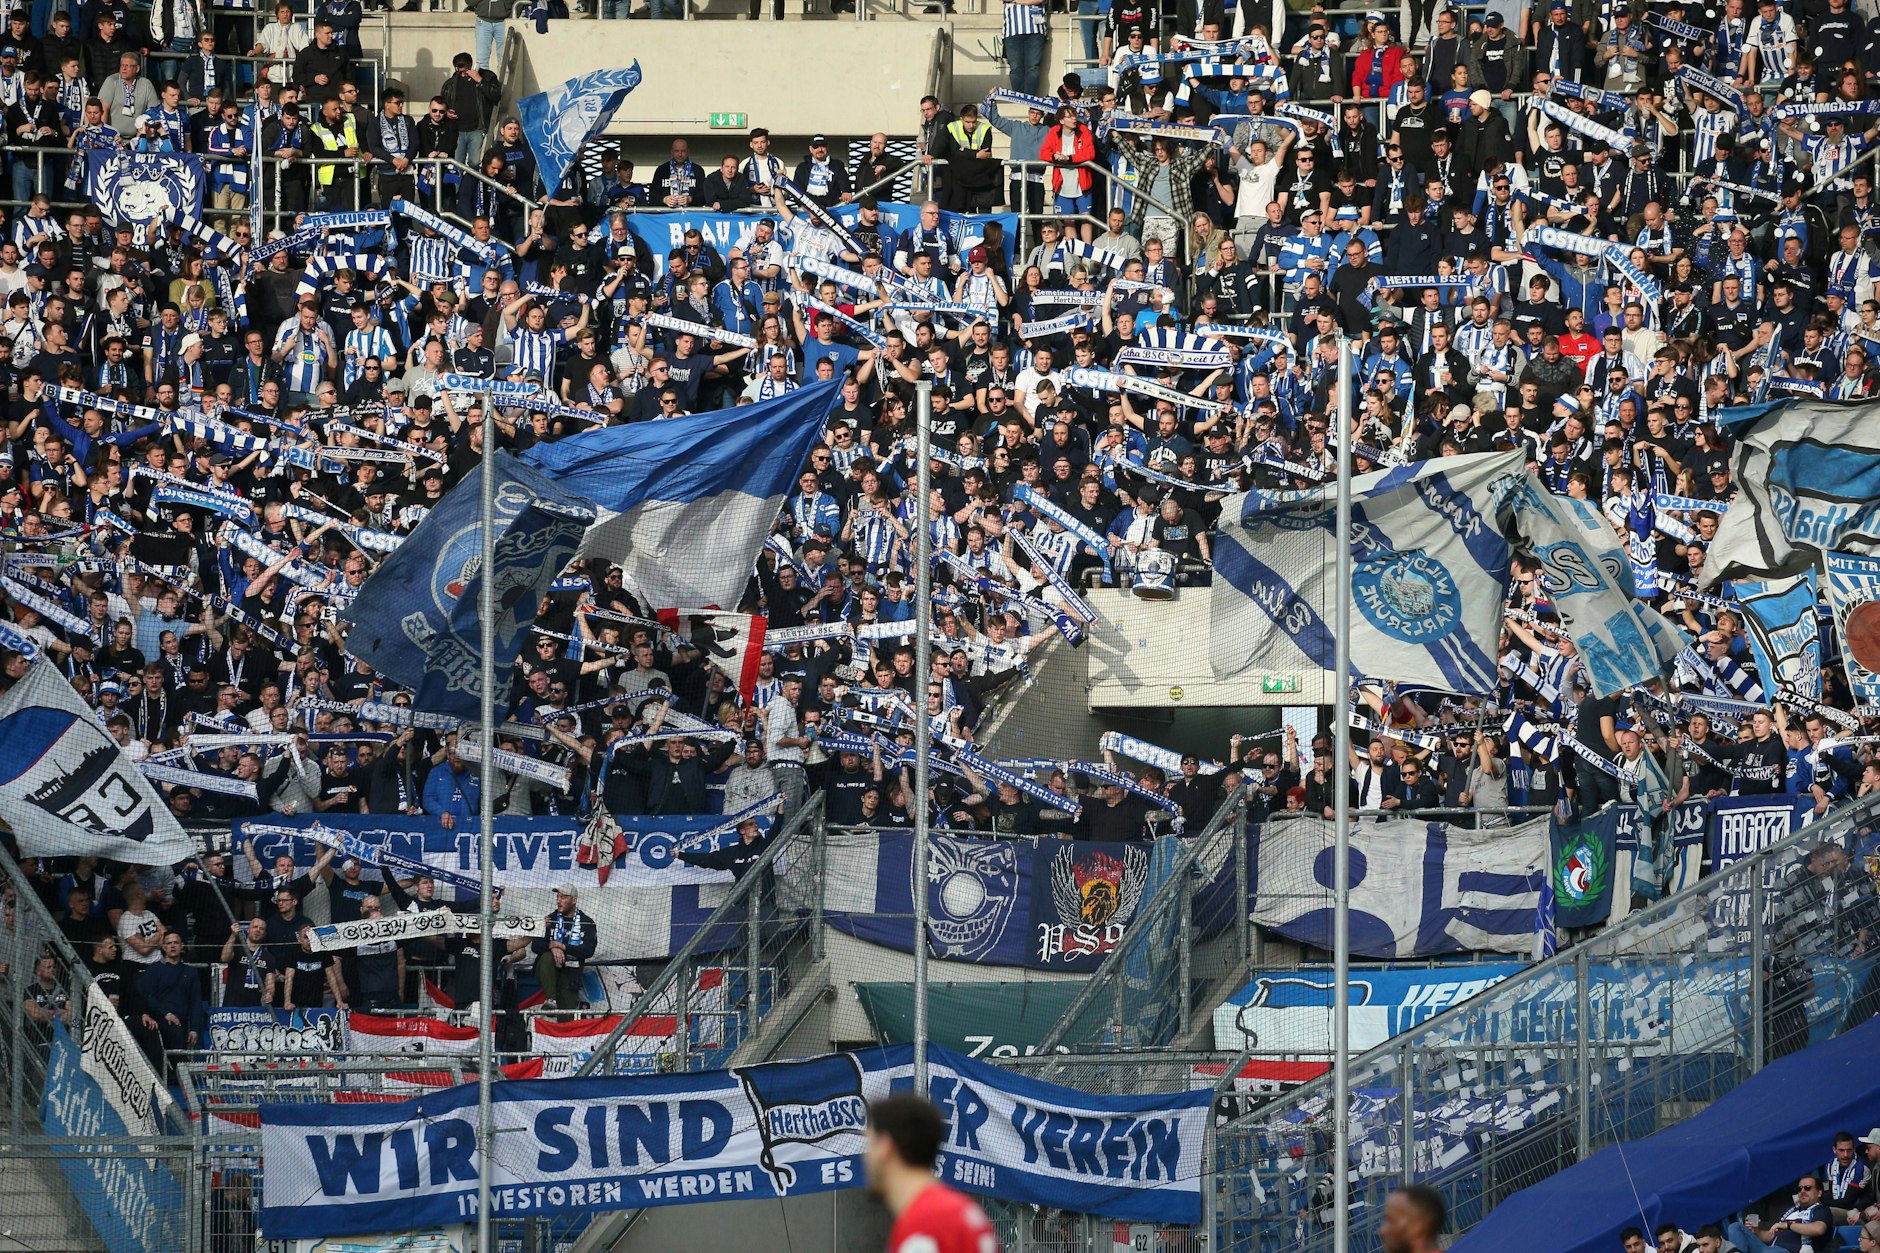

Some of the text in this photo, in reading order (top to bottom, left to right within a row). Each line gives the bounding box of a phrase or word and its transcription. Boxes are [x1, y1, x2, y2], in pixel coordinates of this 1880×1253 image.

[1785, 102, 1864, 117] STAMMGAST
[1129, 119, 1201, 138] 125 JAHRE
[404, 205, 458, 242] HERTHA
[668, 222, 731, 249] BLAU
[1385, 274, 1467, 289] HERTHA BSC
[1604, 245, 1661, 302] OSTKURVE
[1035, 290, 1080, 298] Gemeinsam
[1053, 296, 1102, 305] Hertha BSC
[1143, 349, 1165, 361] BSC
[1188, 353, 1208, 363] seit
[1830, 559, 1855, 570] MIT
[1012, 527, 1094, 622] SUPPORTERS KARLSRUHE
[780, 624, 833, 639] HERTHA BSC
[520, 761, 540, 773] BSC
[139, 919, 157, 937] 153
[343, 913, 446, 940] CREW '08
[210, 1013, 232, 1023] FORZA
[210, 1023, 323, 1052] PSYCHOS
[305, 1099, 734, 1197] WIR SIND
[1011, 1102, 1182, 1182] VEREIN
[457, 1182, 621, 1216] INVESTOREN
[638, 1171, 754, 1199] WERDEN
[821, 1159, 854, 1185] ES
[953, 1160, 996, 1189] SEIN!
[1135, 1234, 1149, 1251] G2
